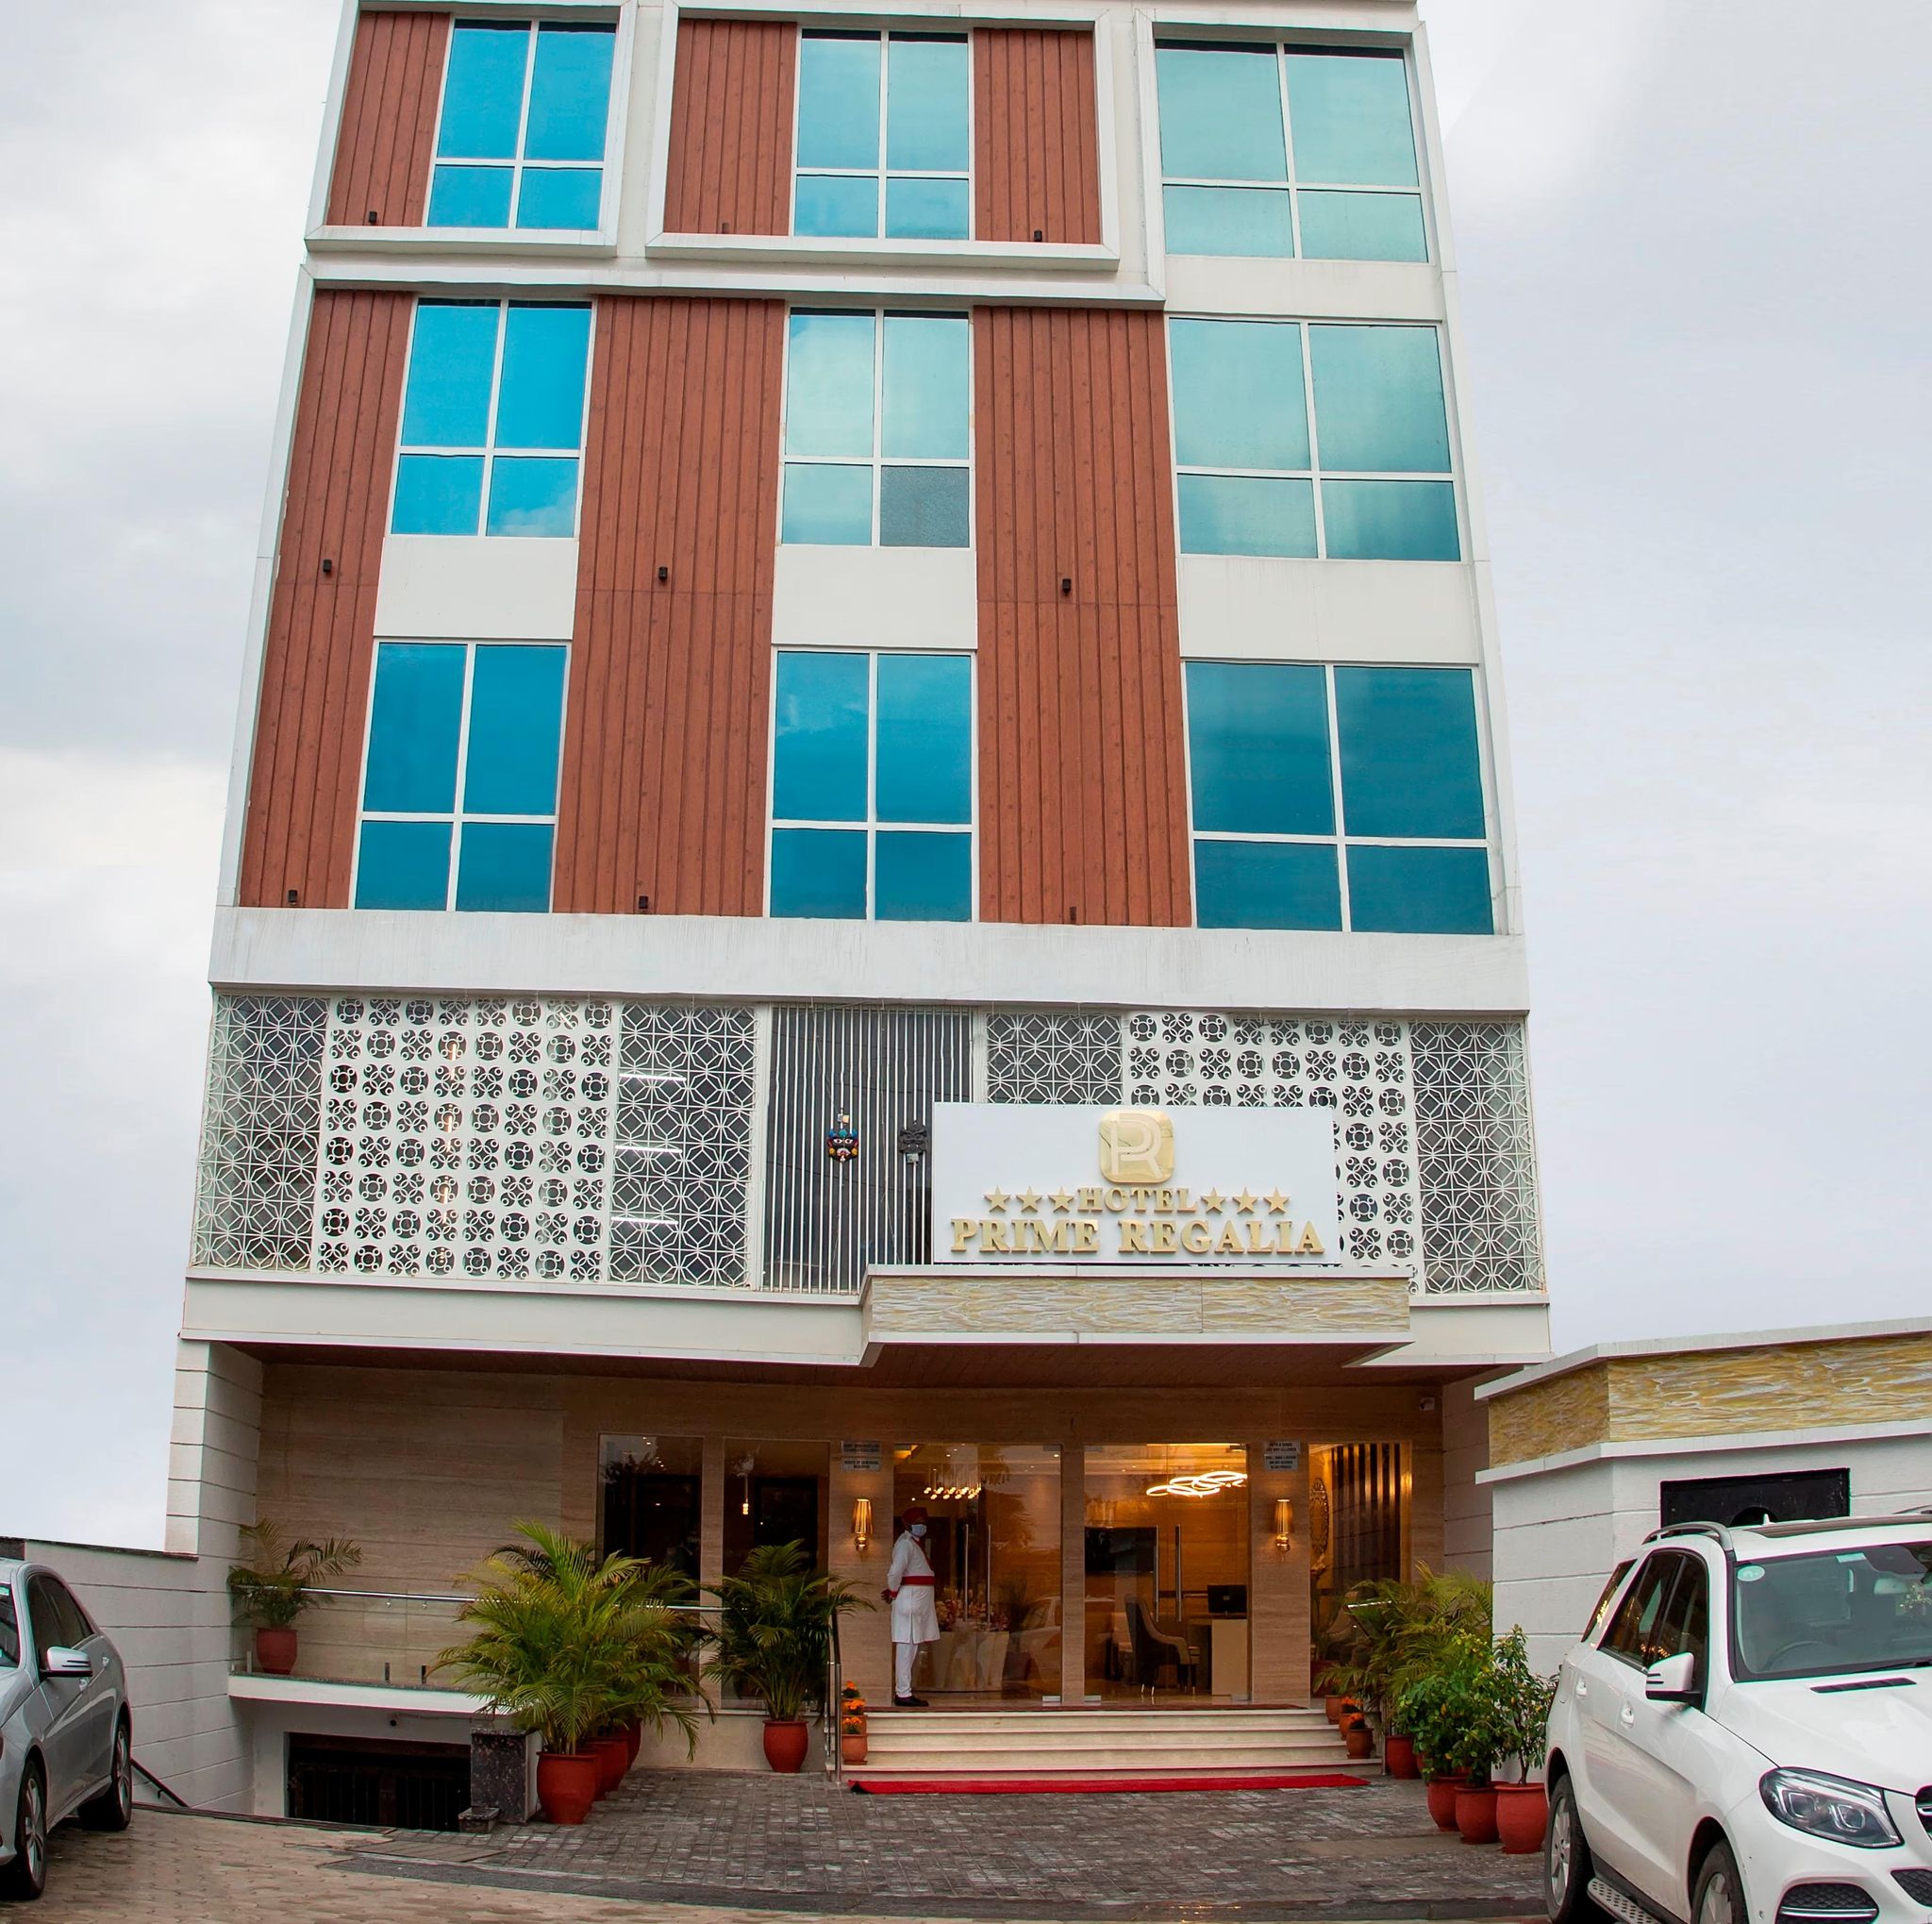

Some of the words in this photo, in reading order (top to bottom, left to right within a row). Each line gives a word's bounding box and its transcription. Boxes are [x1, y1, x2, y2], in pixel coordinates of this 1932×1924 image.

[1077, 1186, 1197, 1213] HOTEL
[951, 1218, 1101, 1253] PRIME
[1118, 1219, 1324, 1254] REGALIA
